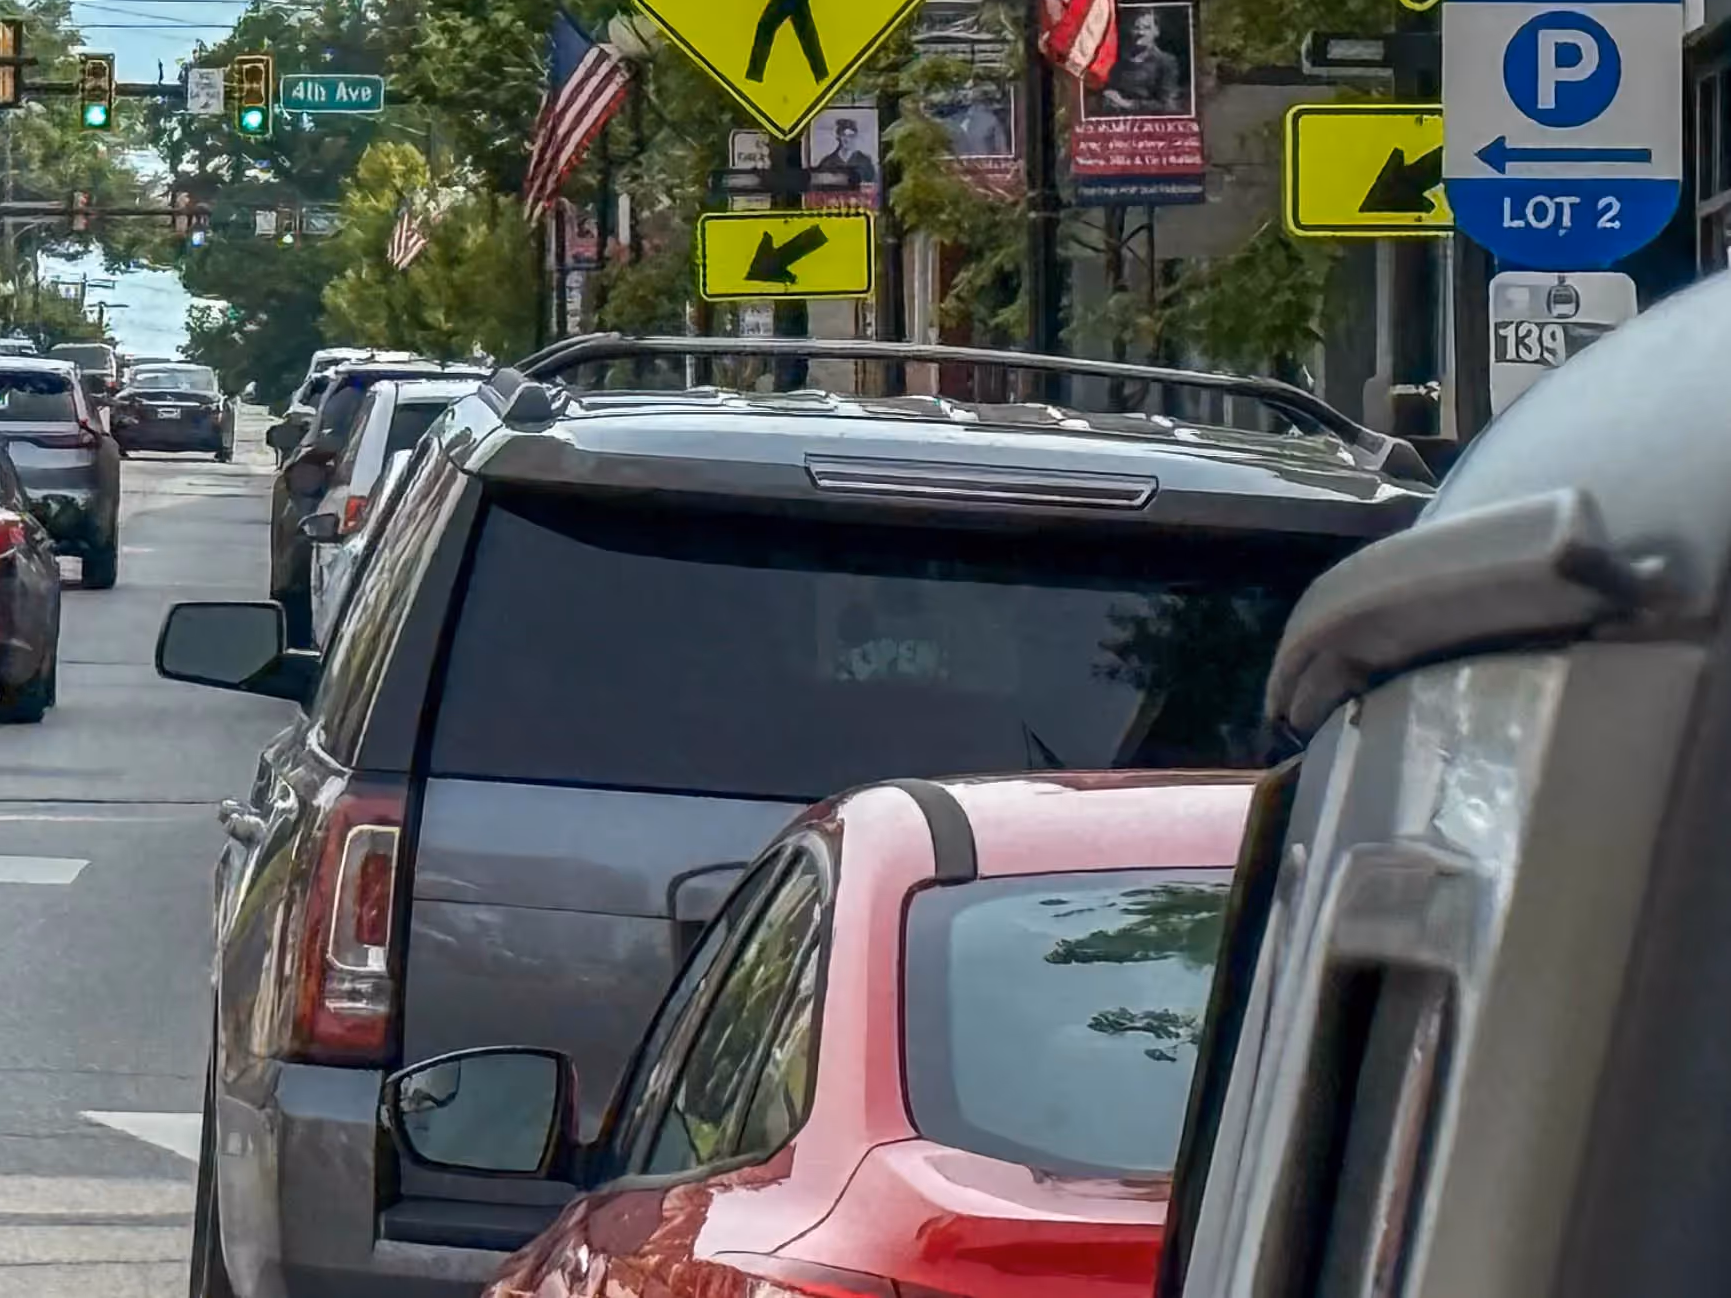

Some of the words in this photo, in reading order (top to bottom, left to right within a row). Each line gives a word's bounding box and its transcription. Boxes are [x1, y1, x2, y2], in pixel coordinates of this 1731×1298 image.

[1537, 29, 1600, 110] P
[292, 81, 326, 102] 4th
[335, 81, 372, 102] Ave
[1502, 196, 1581, 229] LOT
[1596, 196, 1622, 229] 2
[1498, 322, 1566, 366] 139
